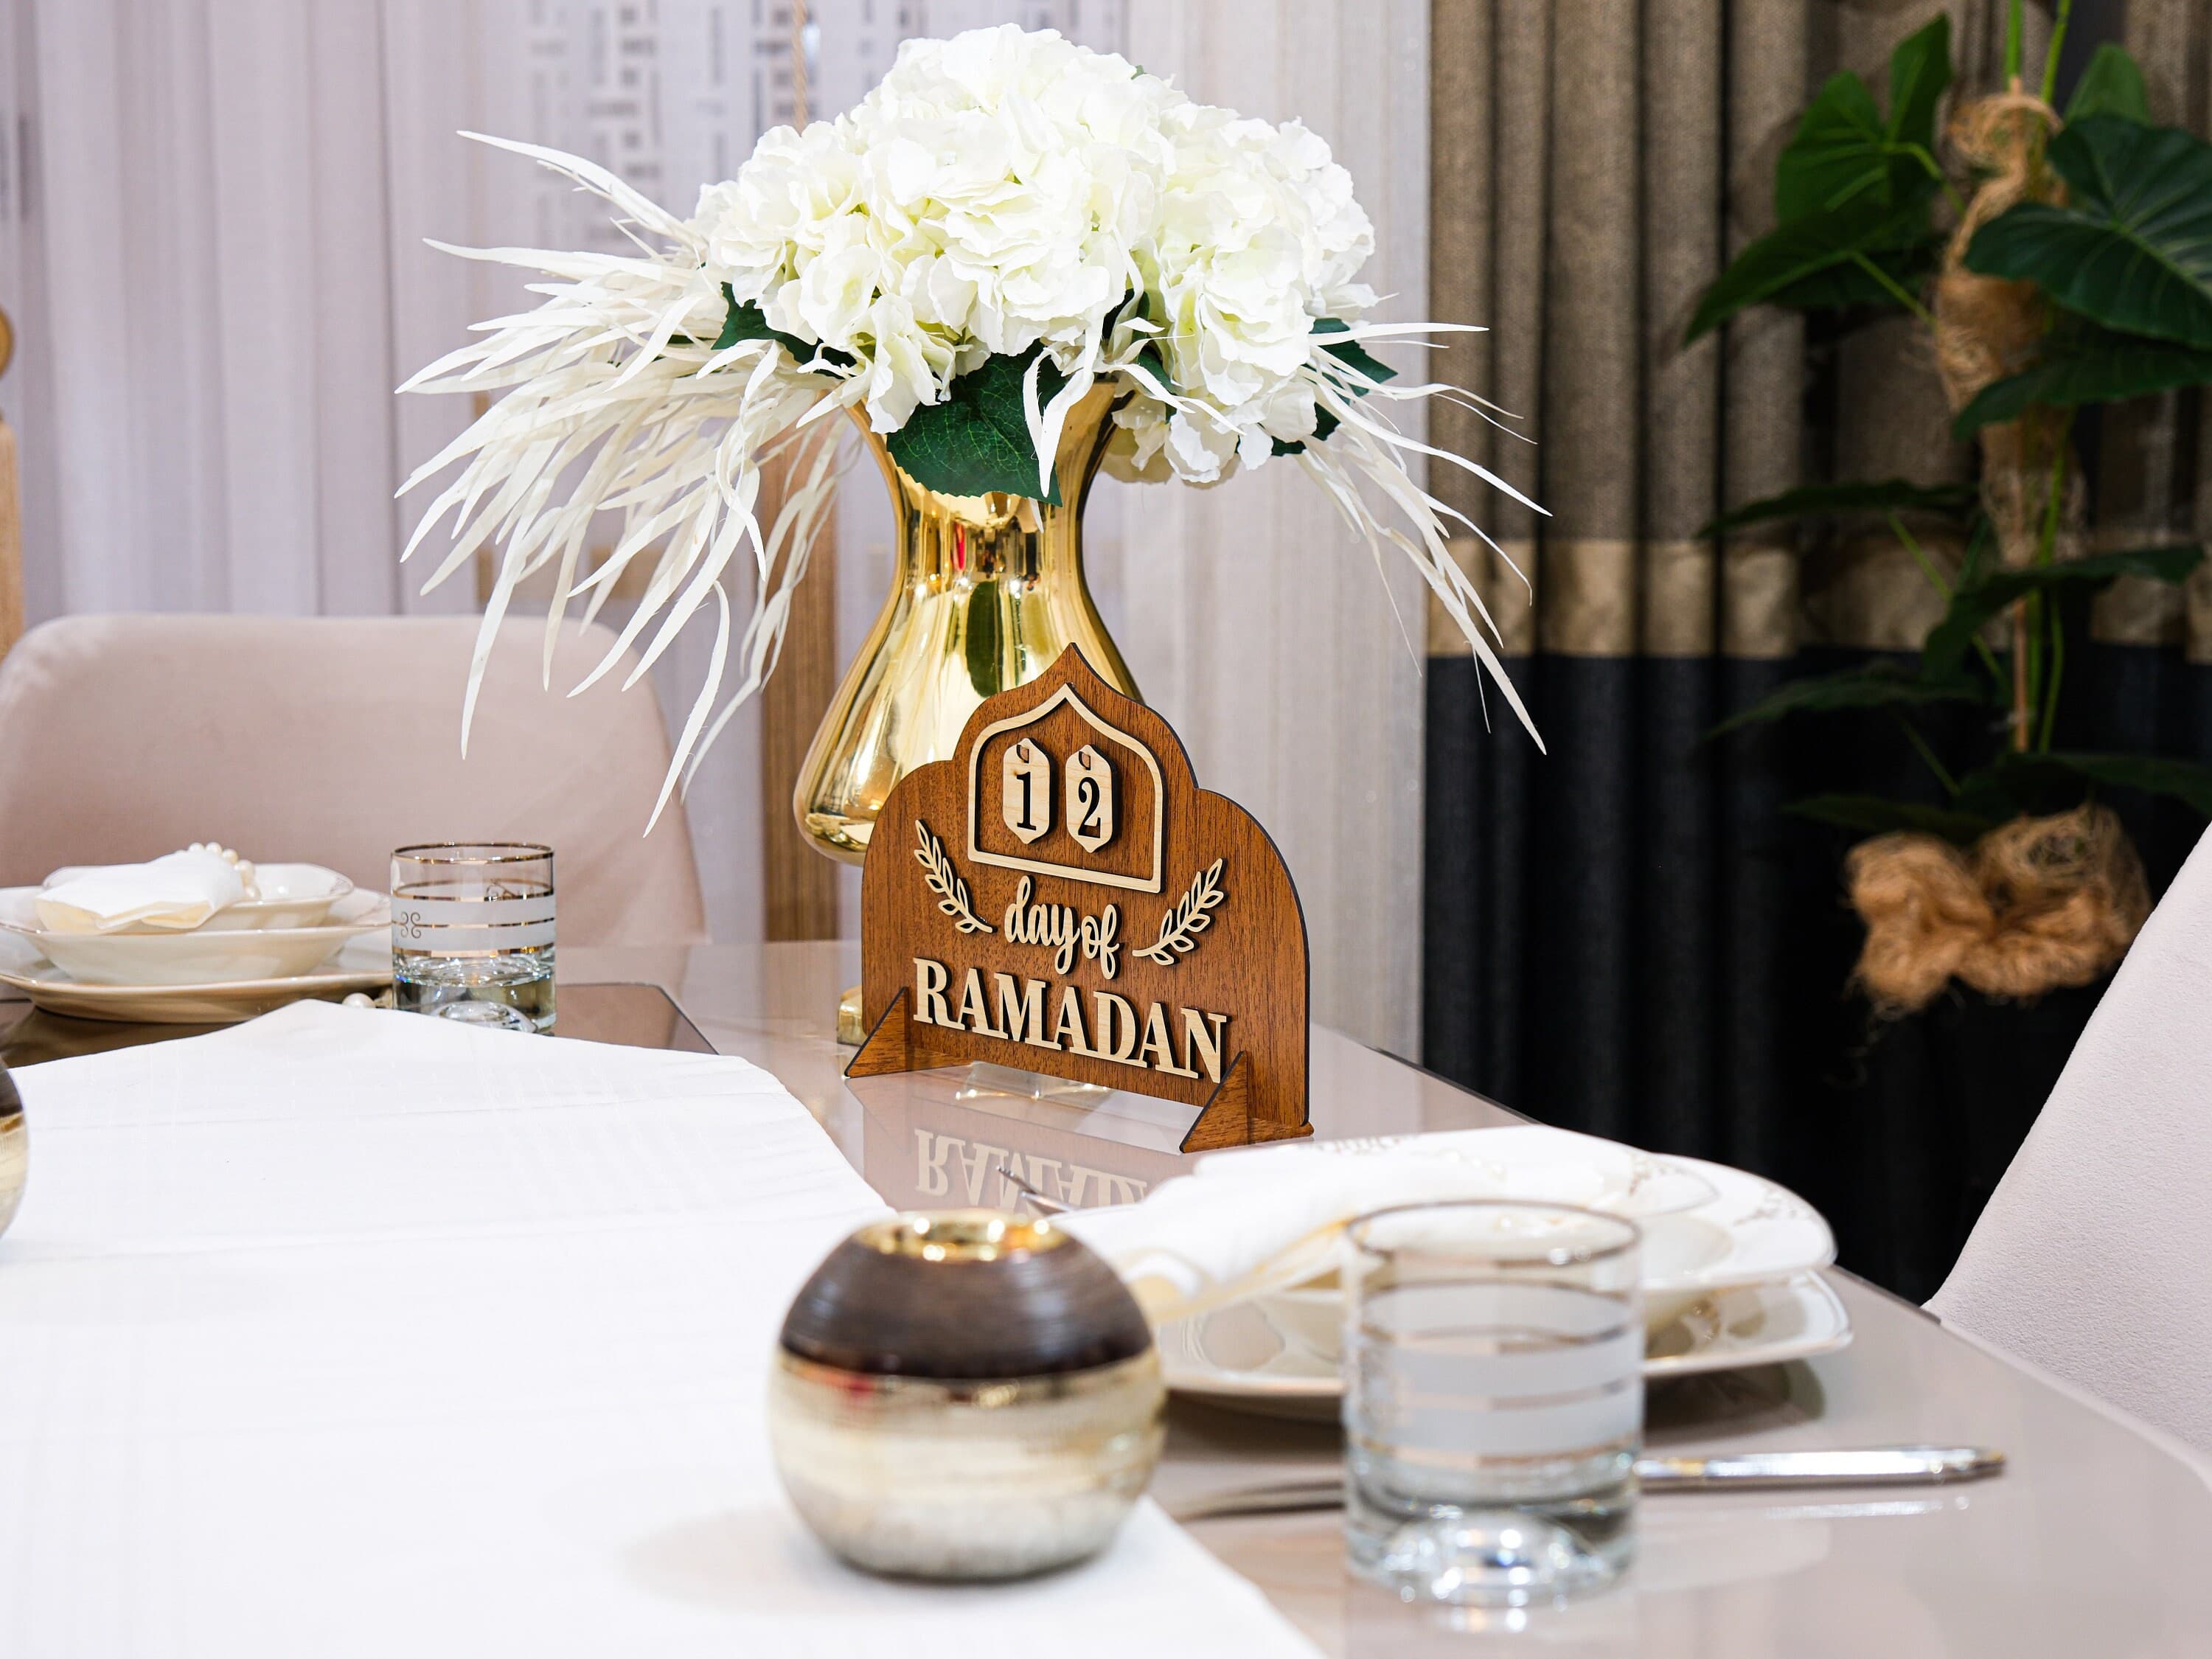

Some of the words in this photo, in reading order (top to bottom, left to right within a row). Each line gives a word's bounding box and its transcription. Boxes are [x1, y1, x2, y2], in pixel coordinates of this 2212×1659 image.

[1004, 874, 1081, 975] day
[1081, 903, 1120, 980] of
[912, 956, 1228, 1085] RAMADAN
